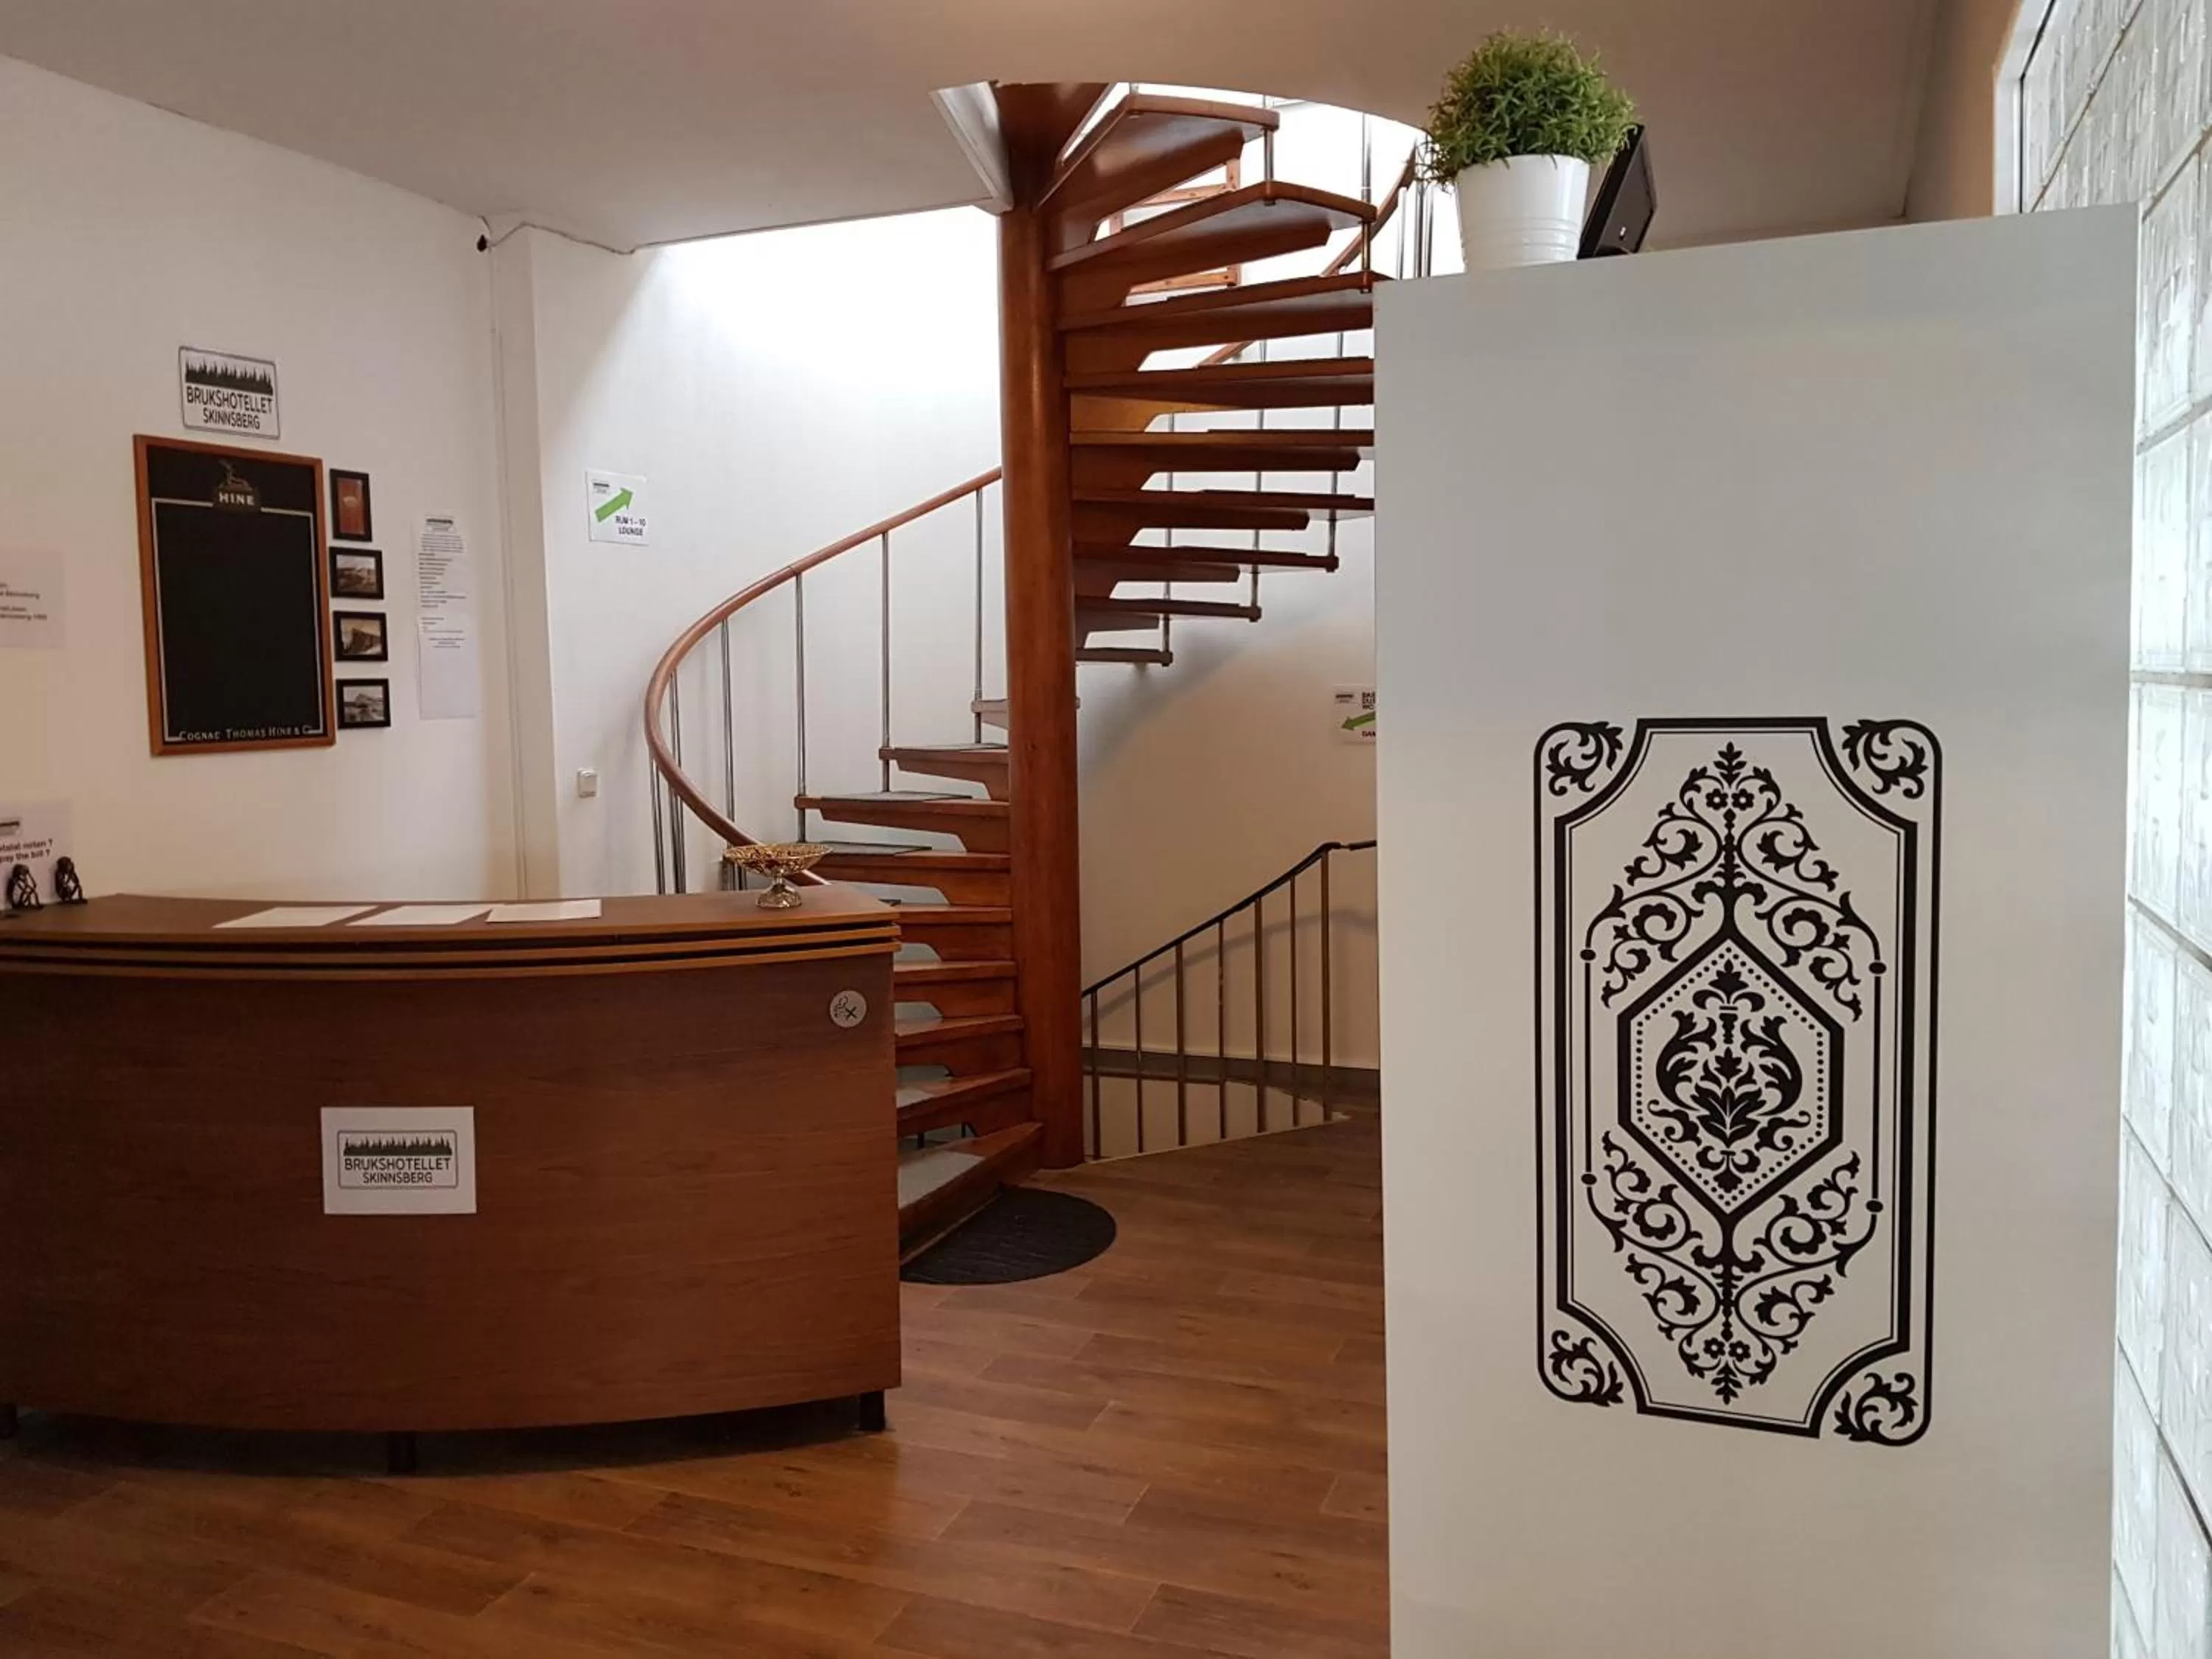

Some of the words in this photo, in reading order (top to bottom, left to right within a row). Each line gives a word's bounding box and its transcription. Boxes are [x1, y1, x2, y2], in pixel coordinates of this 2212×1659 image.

[186, 386, 274, 414] BRUKSHOTELLET
[203, 407, 260, 430] SKINNSBERG
[218, 491, 254, 506] HINE
[179, 731, 221, 742] COGNAC
[226, 728, 266, 740] THOMAS
[268, 726, 293, 737] HINE
[15, 852, 29, 860] the
[344, 1157, 452, 1171] BRUKSHOTELLET
[362, 1172, 434, 1184] SKINNSBERG
